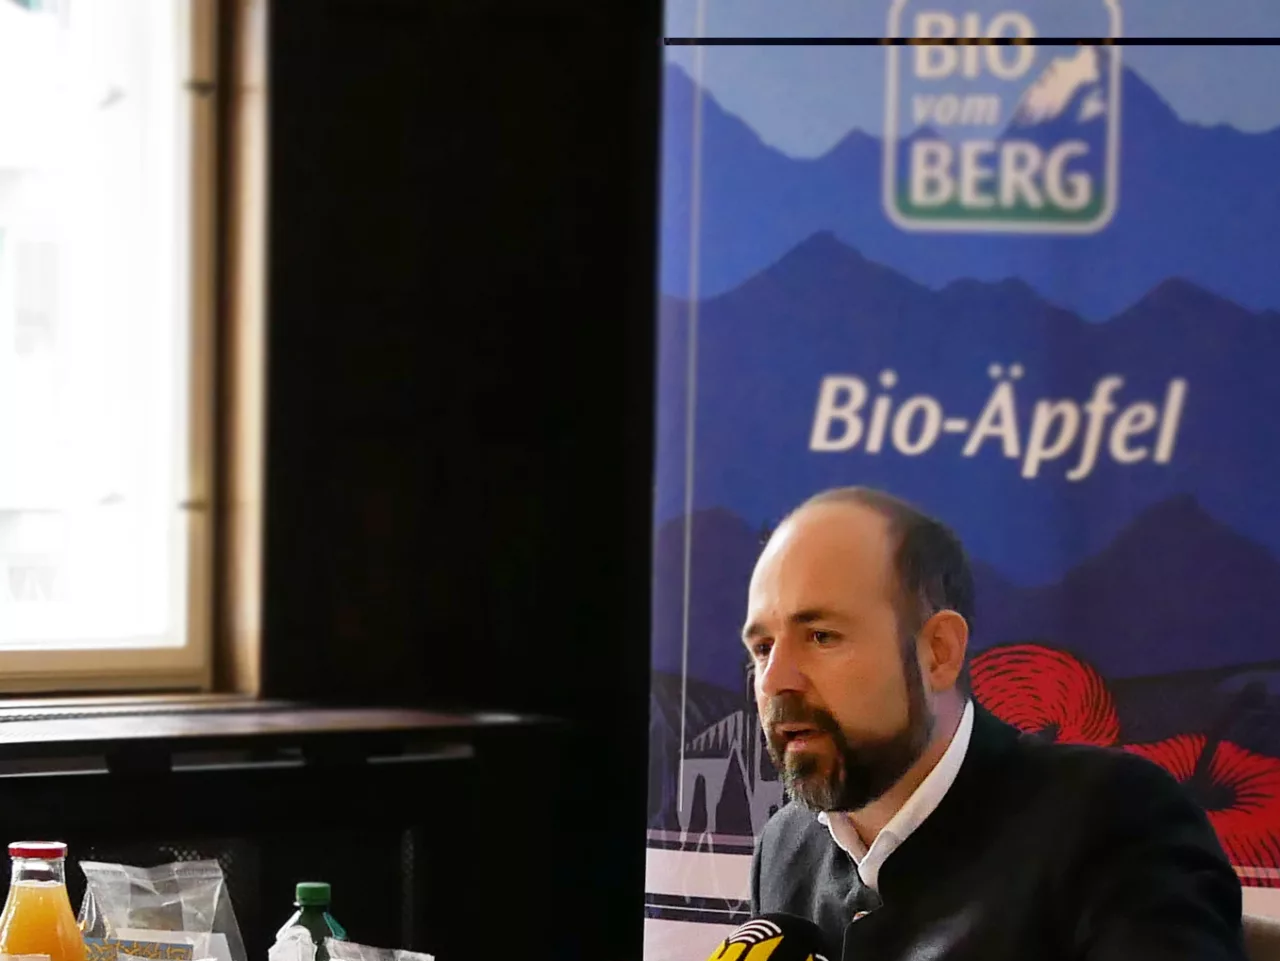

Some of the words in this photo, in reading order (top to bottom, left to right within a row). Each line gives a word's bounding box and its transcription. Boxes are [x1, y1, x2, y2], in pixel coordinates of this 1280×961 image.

[913, 12, 1037, 79] BIO
[912, 94, 999, 127] vom
[909, 140, 1091, 211] BERG
[808, 362, 1187, 481] Bio-Äpfel
